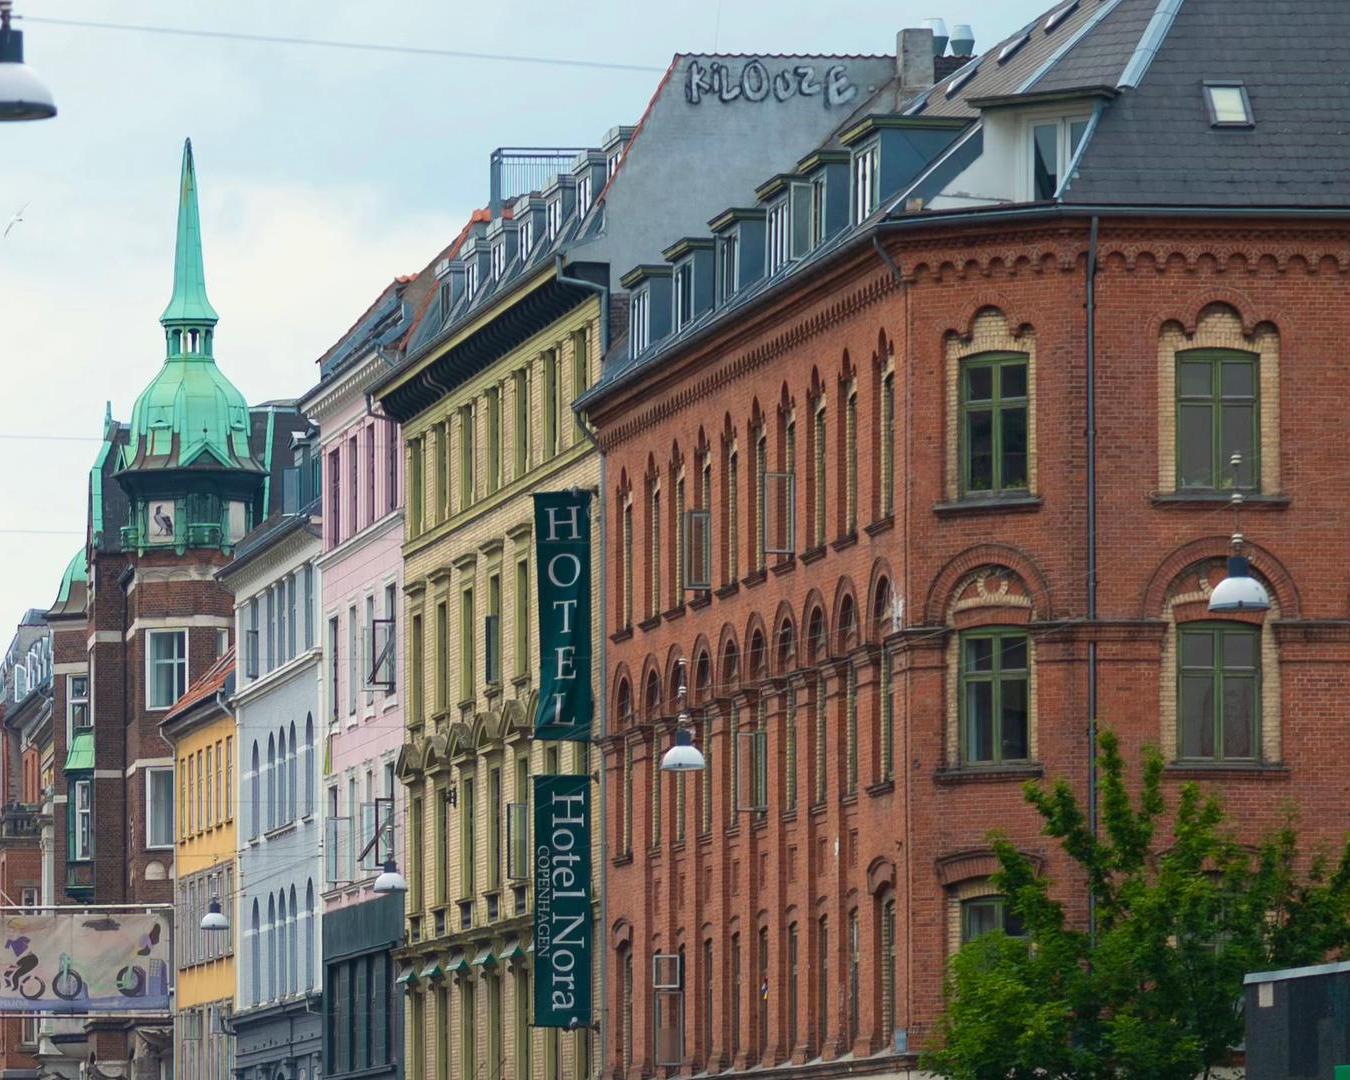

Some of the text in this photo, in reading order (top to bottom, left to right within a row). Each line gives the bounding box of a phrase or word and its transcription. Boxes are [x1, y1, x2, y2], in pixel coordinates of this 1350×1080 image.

[544, 505, 582, 727] HOTEL
[537, 844, 550, 958] COPENHAGEN
[551, 791, 586, 1012] Hotel Nora
